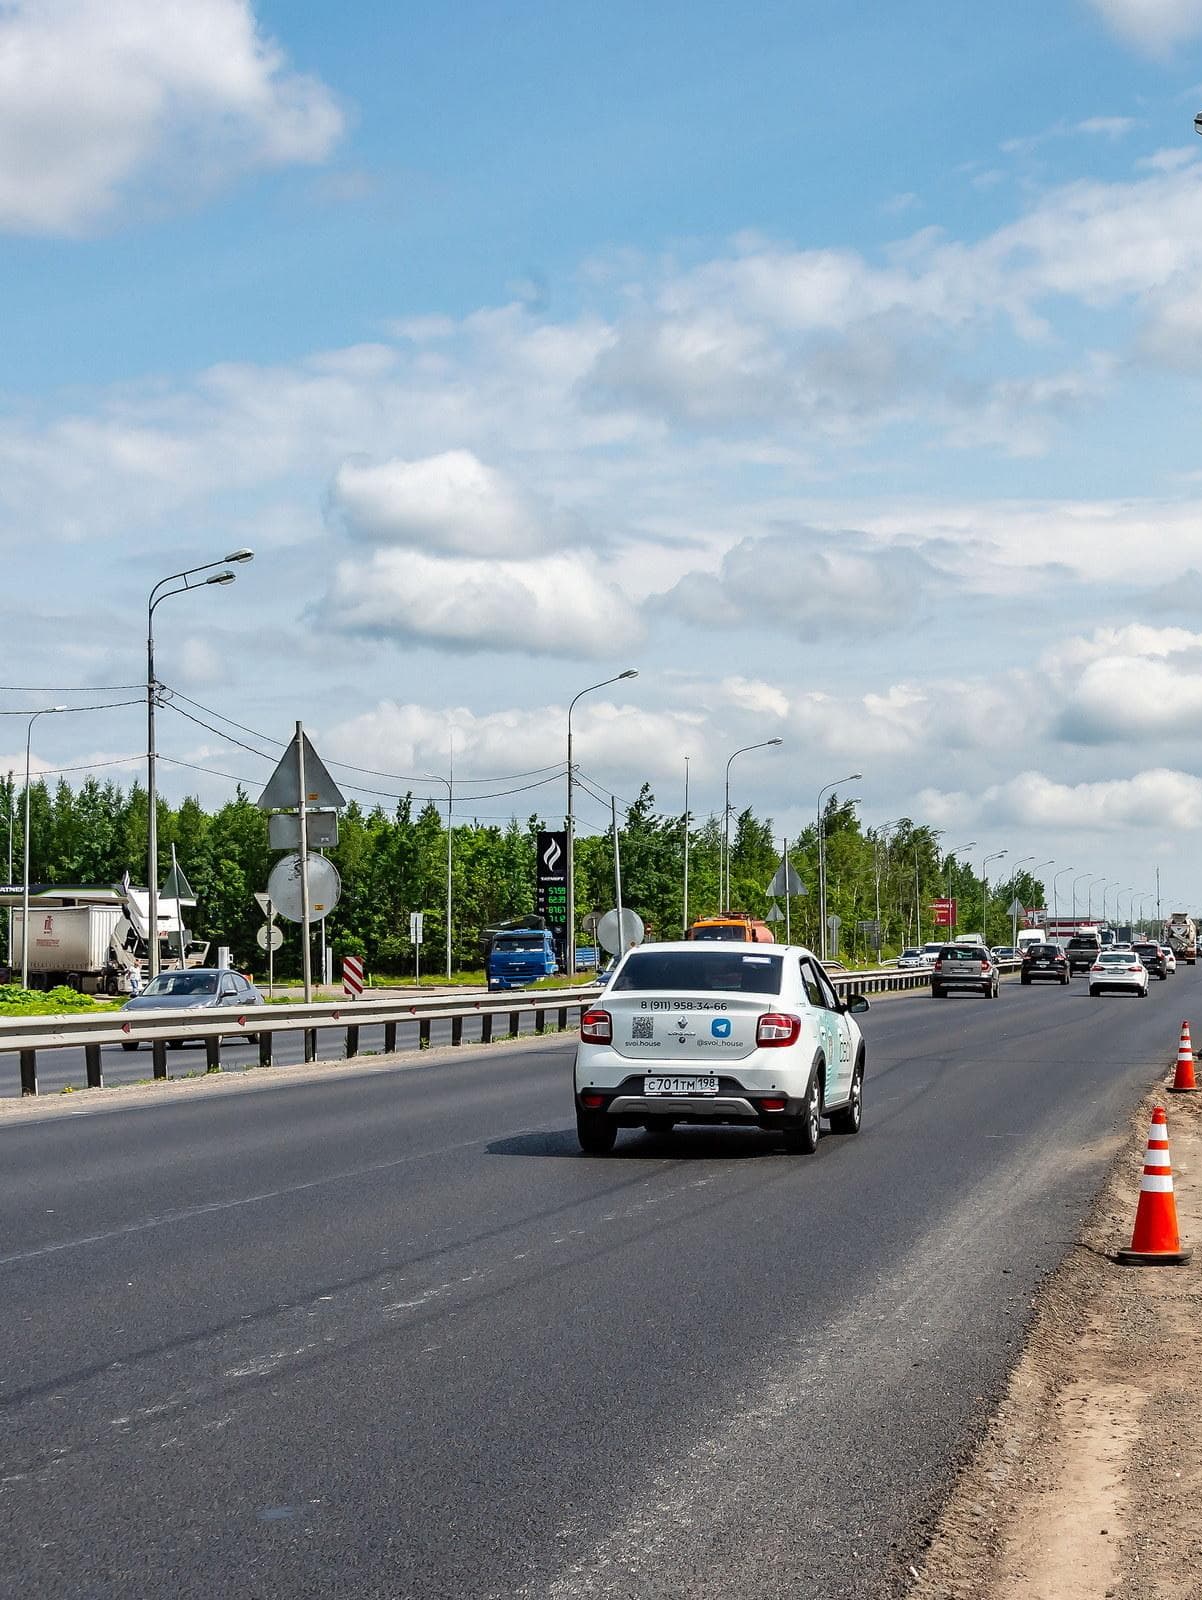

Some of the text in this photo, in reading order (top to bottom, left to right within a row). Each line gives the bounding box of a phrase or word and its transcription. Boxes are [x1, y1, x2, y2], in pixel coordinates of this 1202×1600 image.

[640, 1001, 728, 1011] 8 (911) 958-34-66
[697, 1079, 715, 1090] 198
